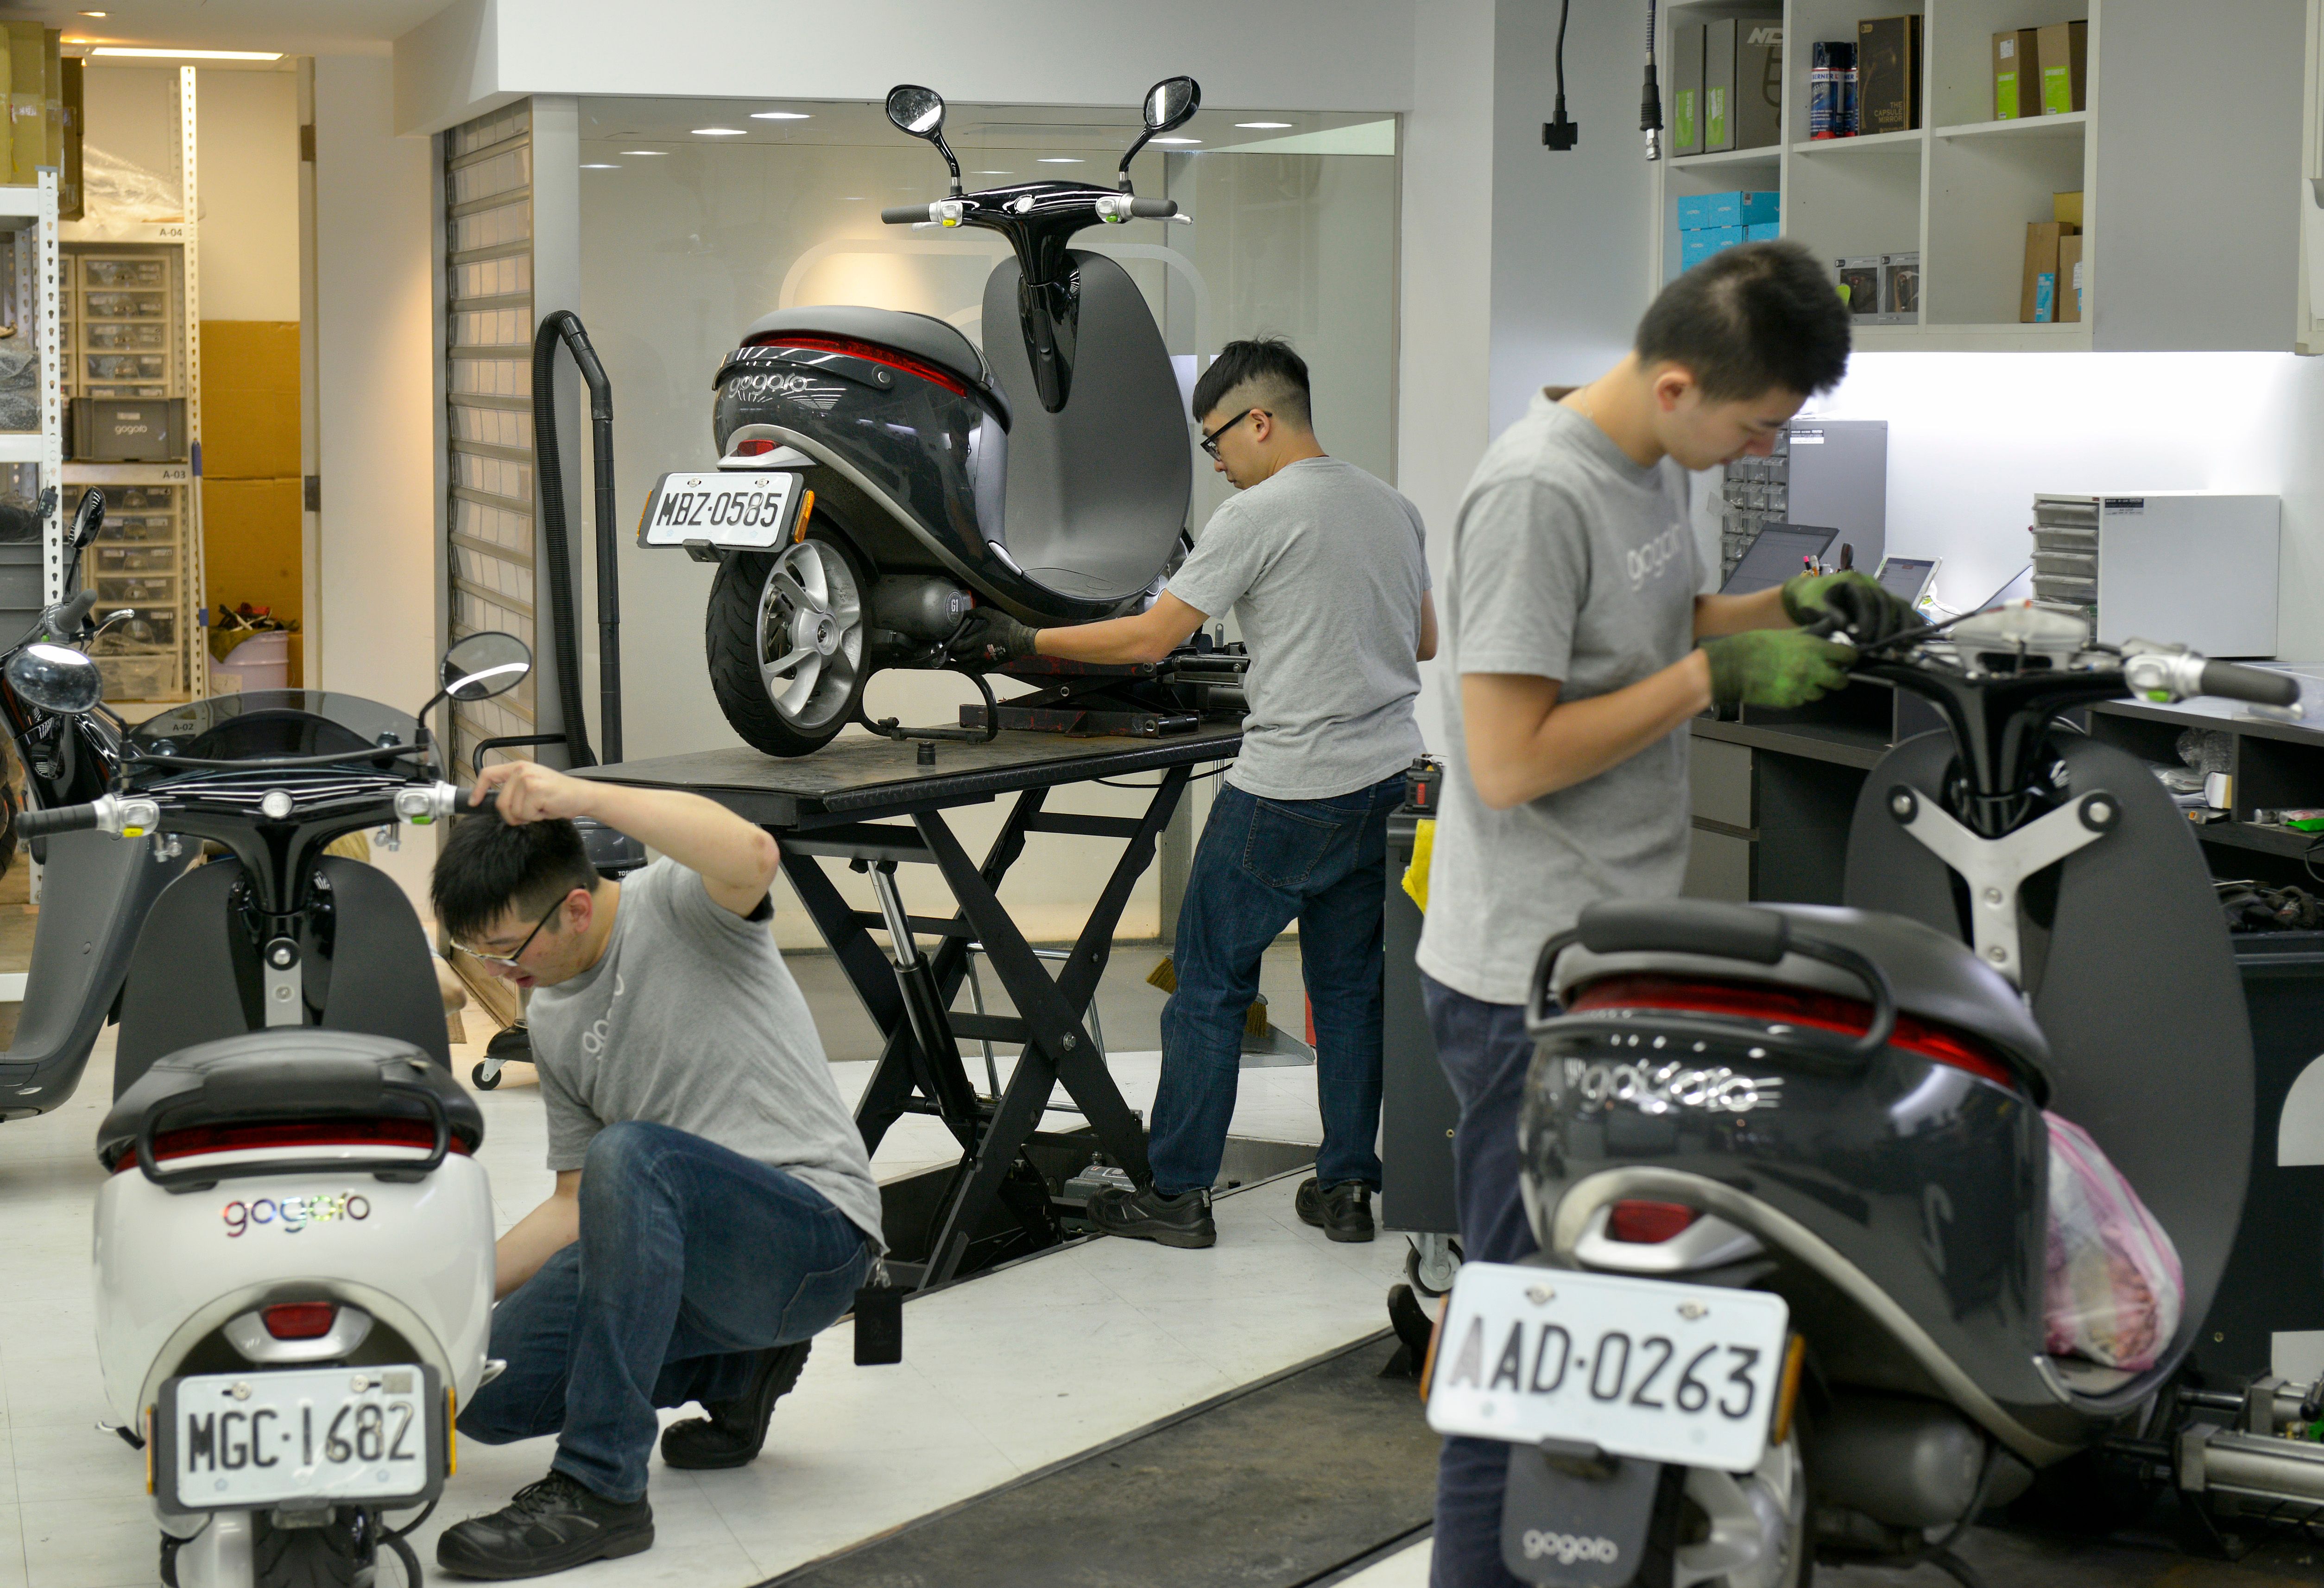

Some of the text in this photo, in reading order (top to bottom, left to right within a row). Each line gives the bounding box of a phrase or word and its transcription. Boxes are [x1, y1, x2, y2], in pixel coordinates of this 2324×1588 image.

[1874, 108, 1902, 117] CAPSULE
[160, 228, 182, 237] A-04
[729, 372, 807, 399] gogoro
[115, 425, 147, 435] gogoro
[163, 471, 186, 479] A-03
[951, 599, 958, 612] G1
[1581, 1063, 1758, 1114] gogoro
[223, 1192, 371, 1237] gogoro
[1522, 1529, 1619, 1565] gogoro
